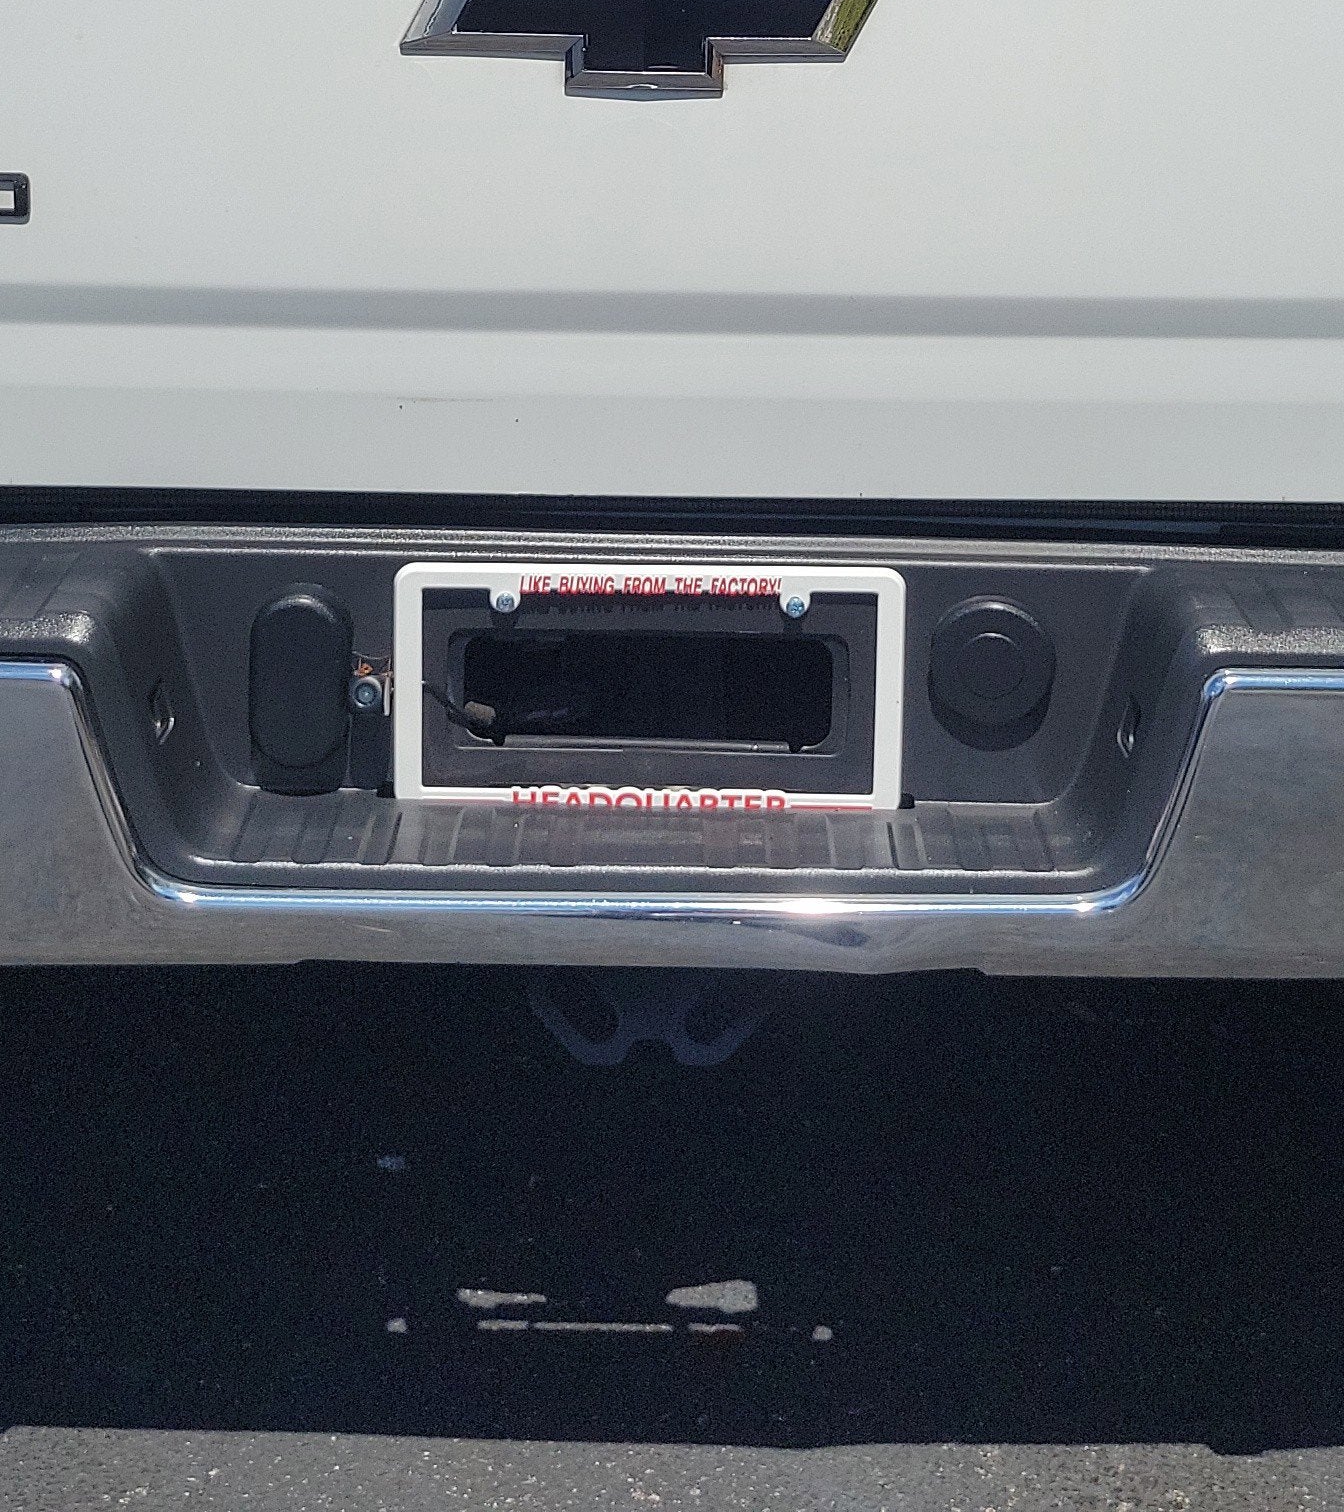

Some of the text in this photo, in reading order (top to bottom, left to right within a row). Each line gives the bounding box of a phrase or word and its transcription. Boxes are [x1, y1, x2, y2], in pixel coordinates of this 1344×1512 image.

[519, 575, 783, 596] LIKE BUYING FROM THE FACTORY!
